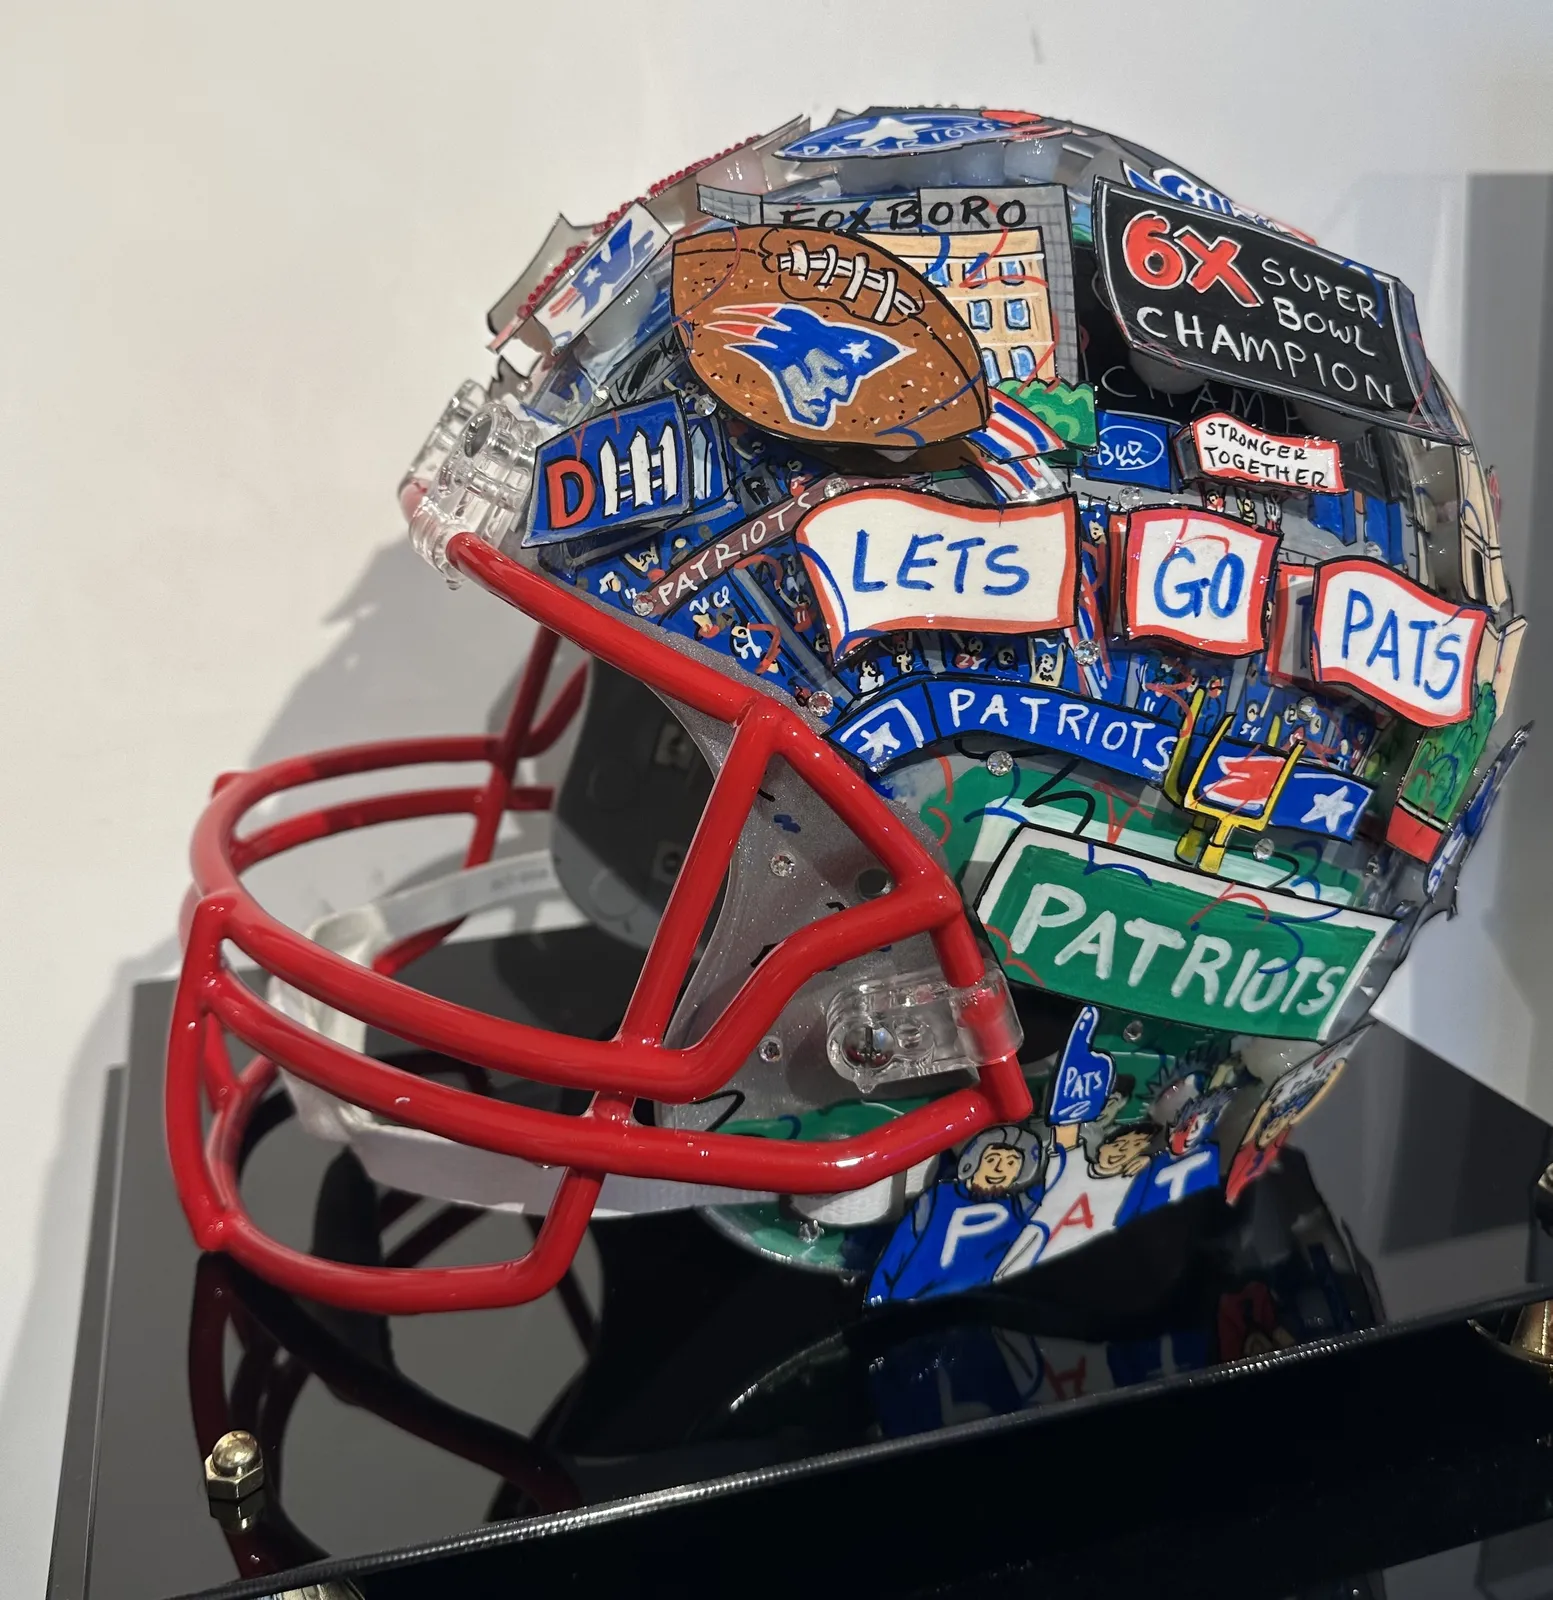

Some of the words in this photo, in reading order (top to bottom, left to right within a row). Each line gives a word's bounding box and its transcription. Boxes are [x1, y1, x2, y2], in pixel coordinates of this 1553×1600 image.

[803, 122, 994, 157] PATRIOTS
[1122, 210, 1264, 308] 6X
[1262, 258, 1382, 323] SUPER
[1135, 306, 1397, 408] CHAMPION
[1273, 296, 1376, 357] BOWL
[1203, 446, 1329, 489] TOGETHER
[1205, 421, 1308, 461] STRONGER
[655, 492, 813, 606] PATRIOTS
[851, 528, 1031, 597] LETS
[1152, 545, 1246, 620] GO
[1341, 587, 1463, 701] PATS
[949, 688, 1178, 773] PATRIOTS
[1010, 882, 1346, 1017] PATRIOTS
[1064, 1066, 1102, 1099] PATS
